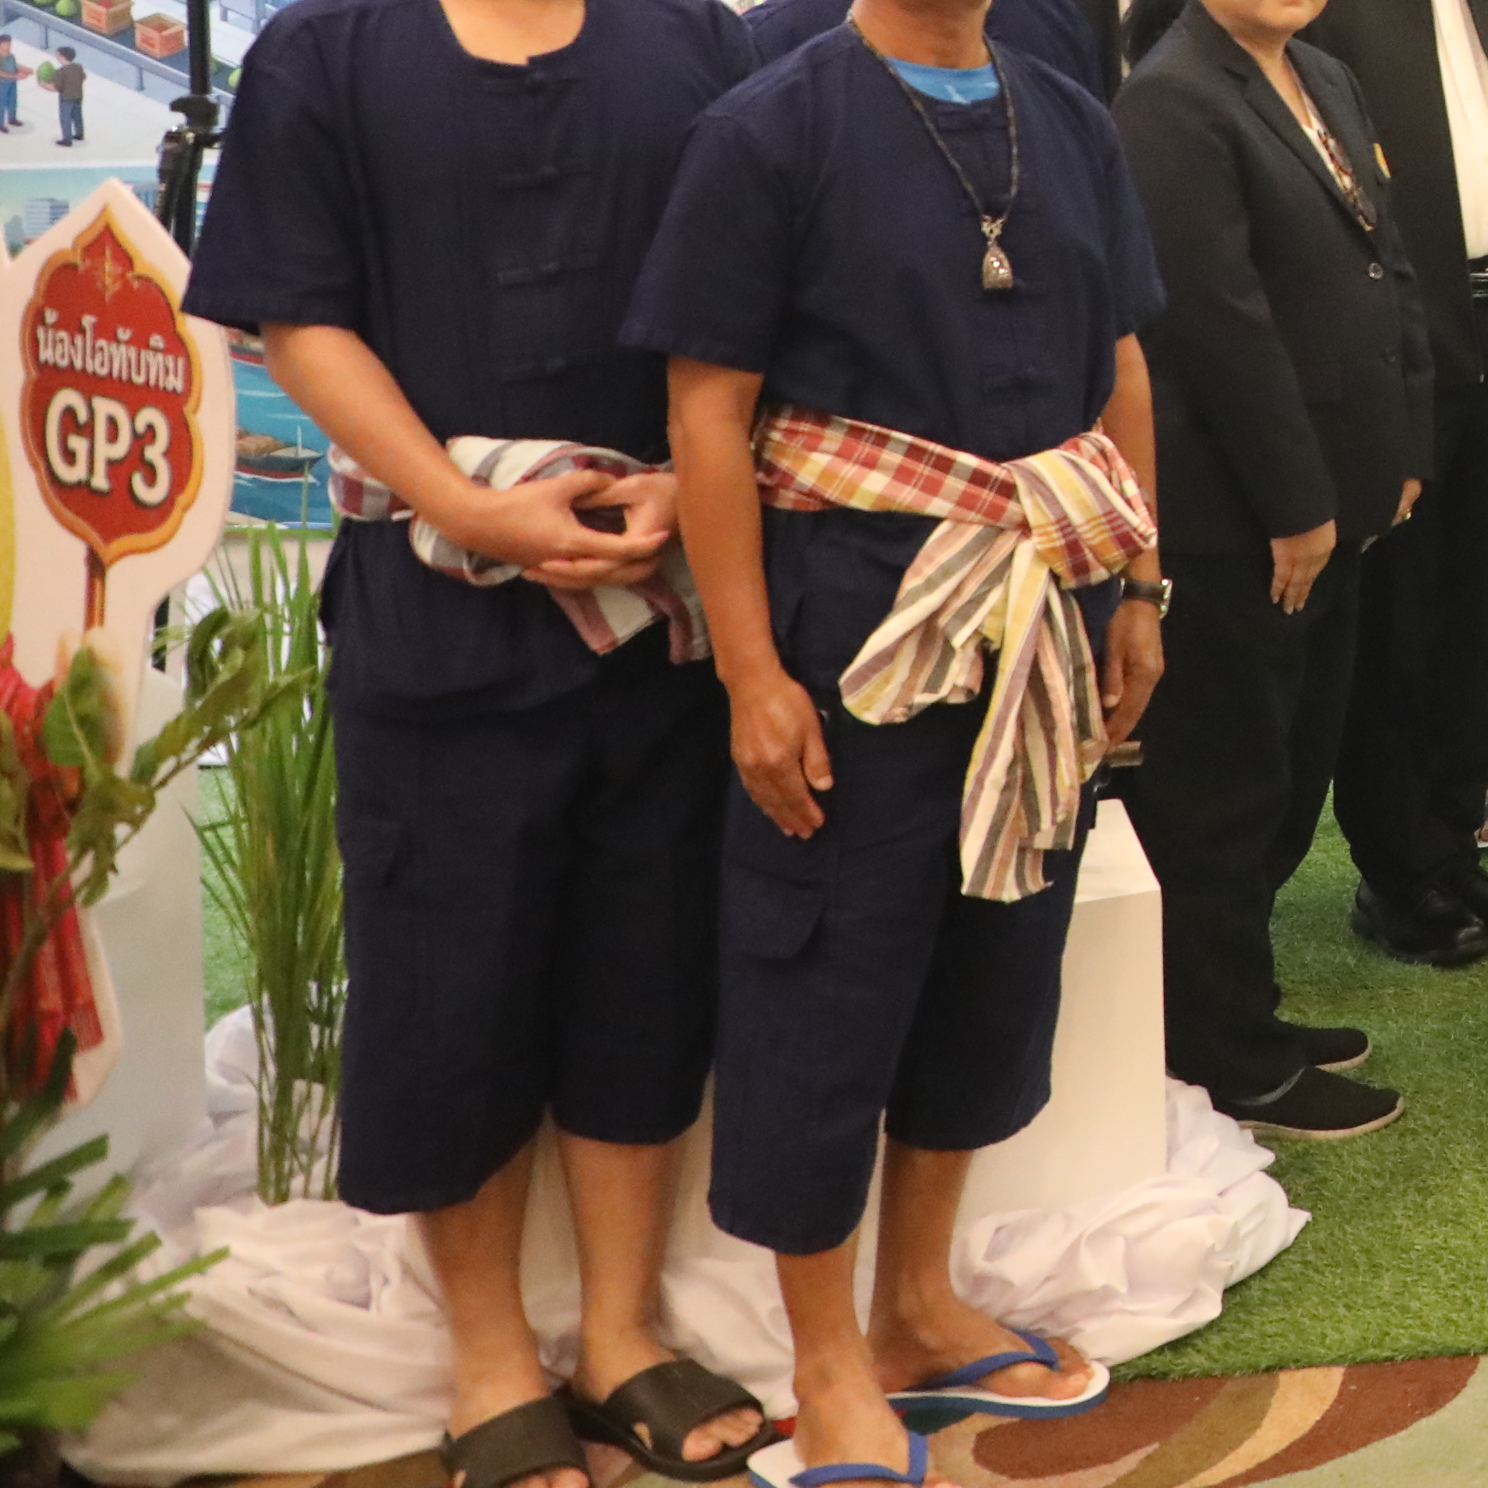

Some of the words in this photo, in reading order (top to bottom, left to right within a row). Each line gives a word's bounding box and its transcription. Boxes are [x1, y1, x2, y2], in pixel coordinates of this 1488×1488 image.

[37, 308, 185, 394] น้องโอทับทิม
[45, 386, 173, 507] GP3
